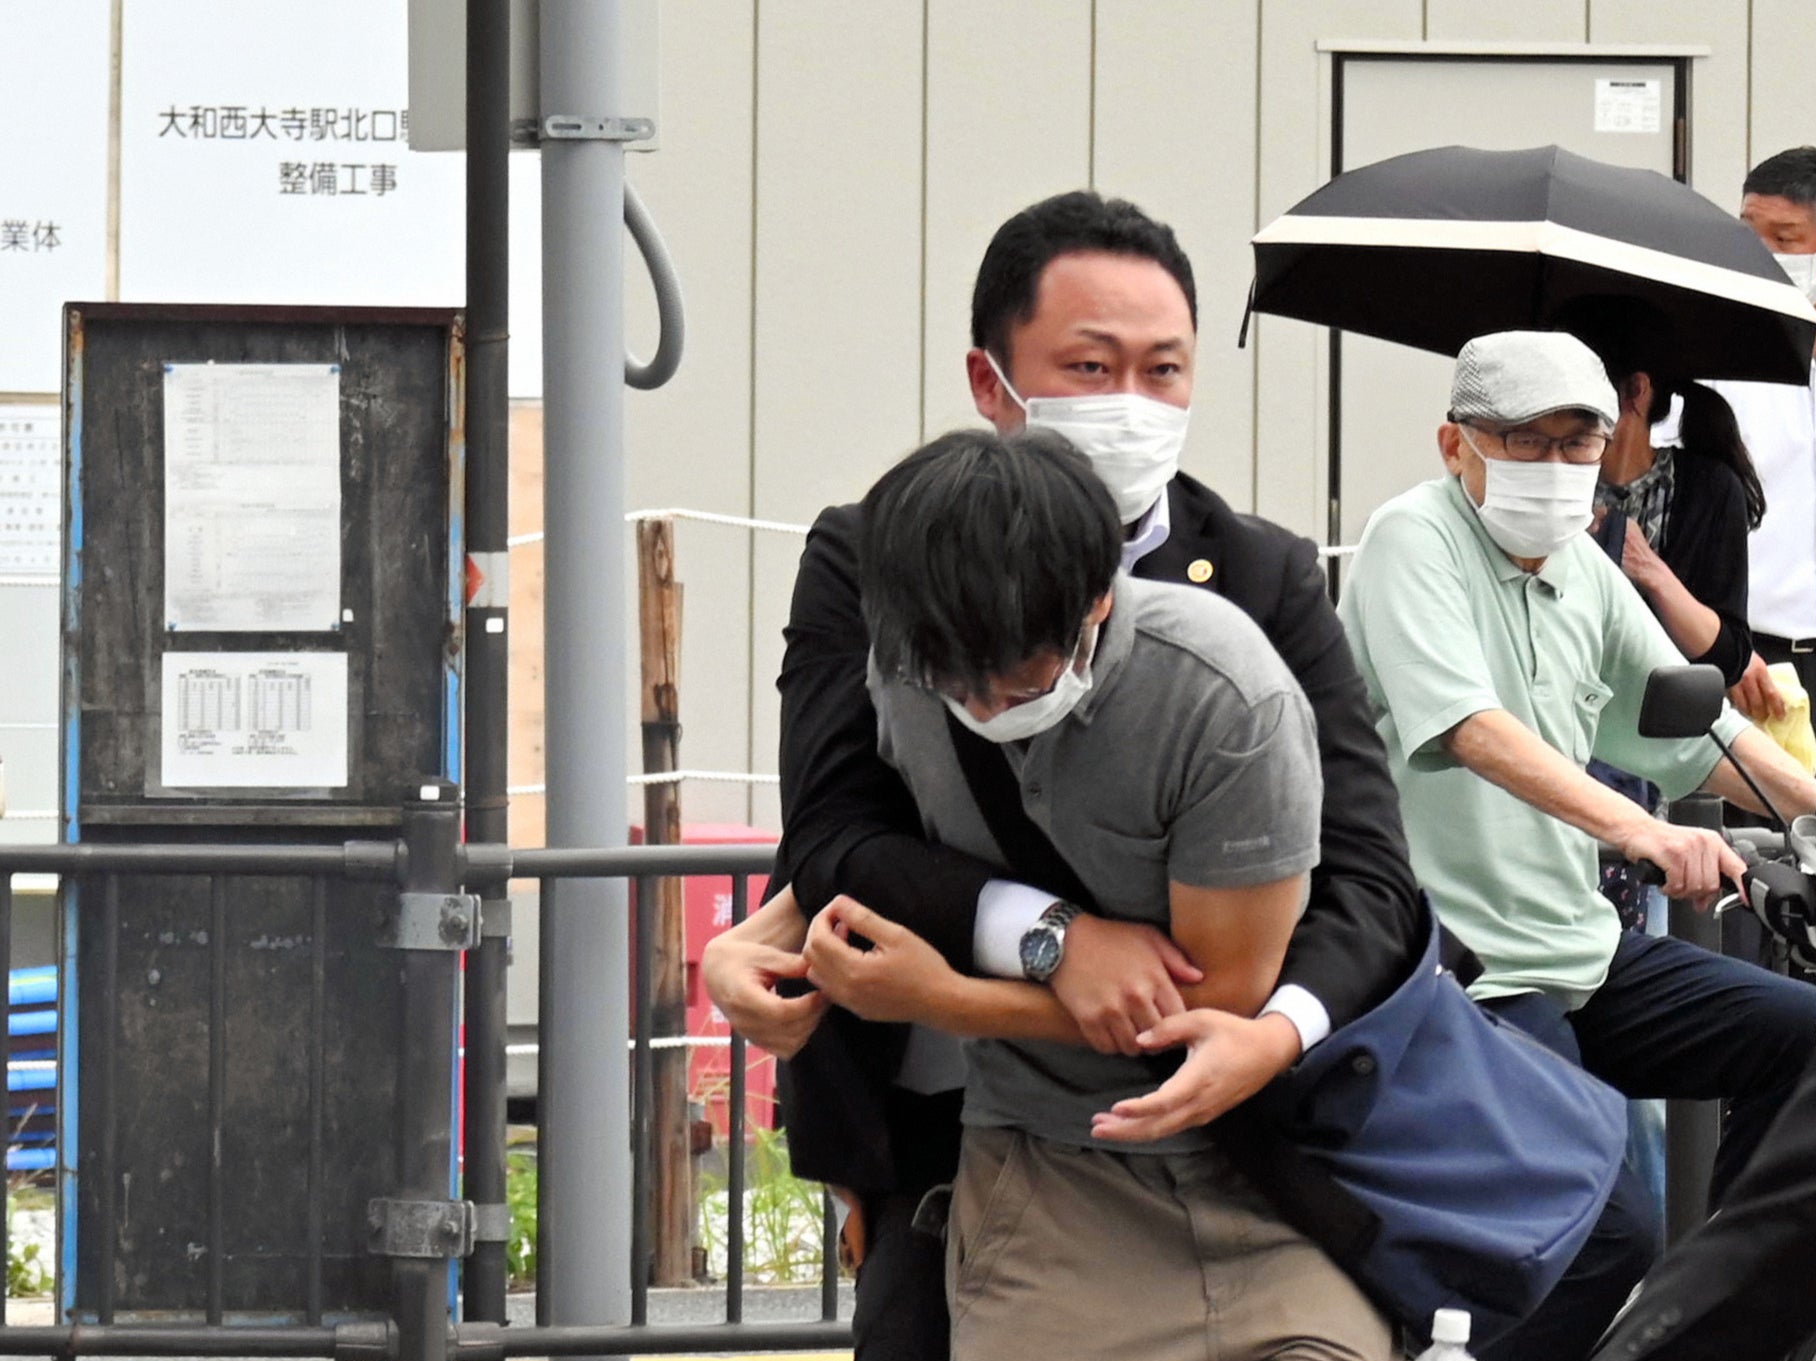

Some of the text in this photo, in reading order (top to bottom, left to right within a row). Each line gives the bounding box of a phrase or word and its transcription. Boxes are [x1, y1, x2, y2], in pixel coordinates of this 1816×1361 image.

[158, 104, 410, 142] 大和西大寺駅北口
[278, 162, 397, 196] 整備工事
[1, 220, 62, 252] 業体
